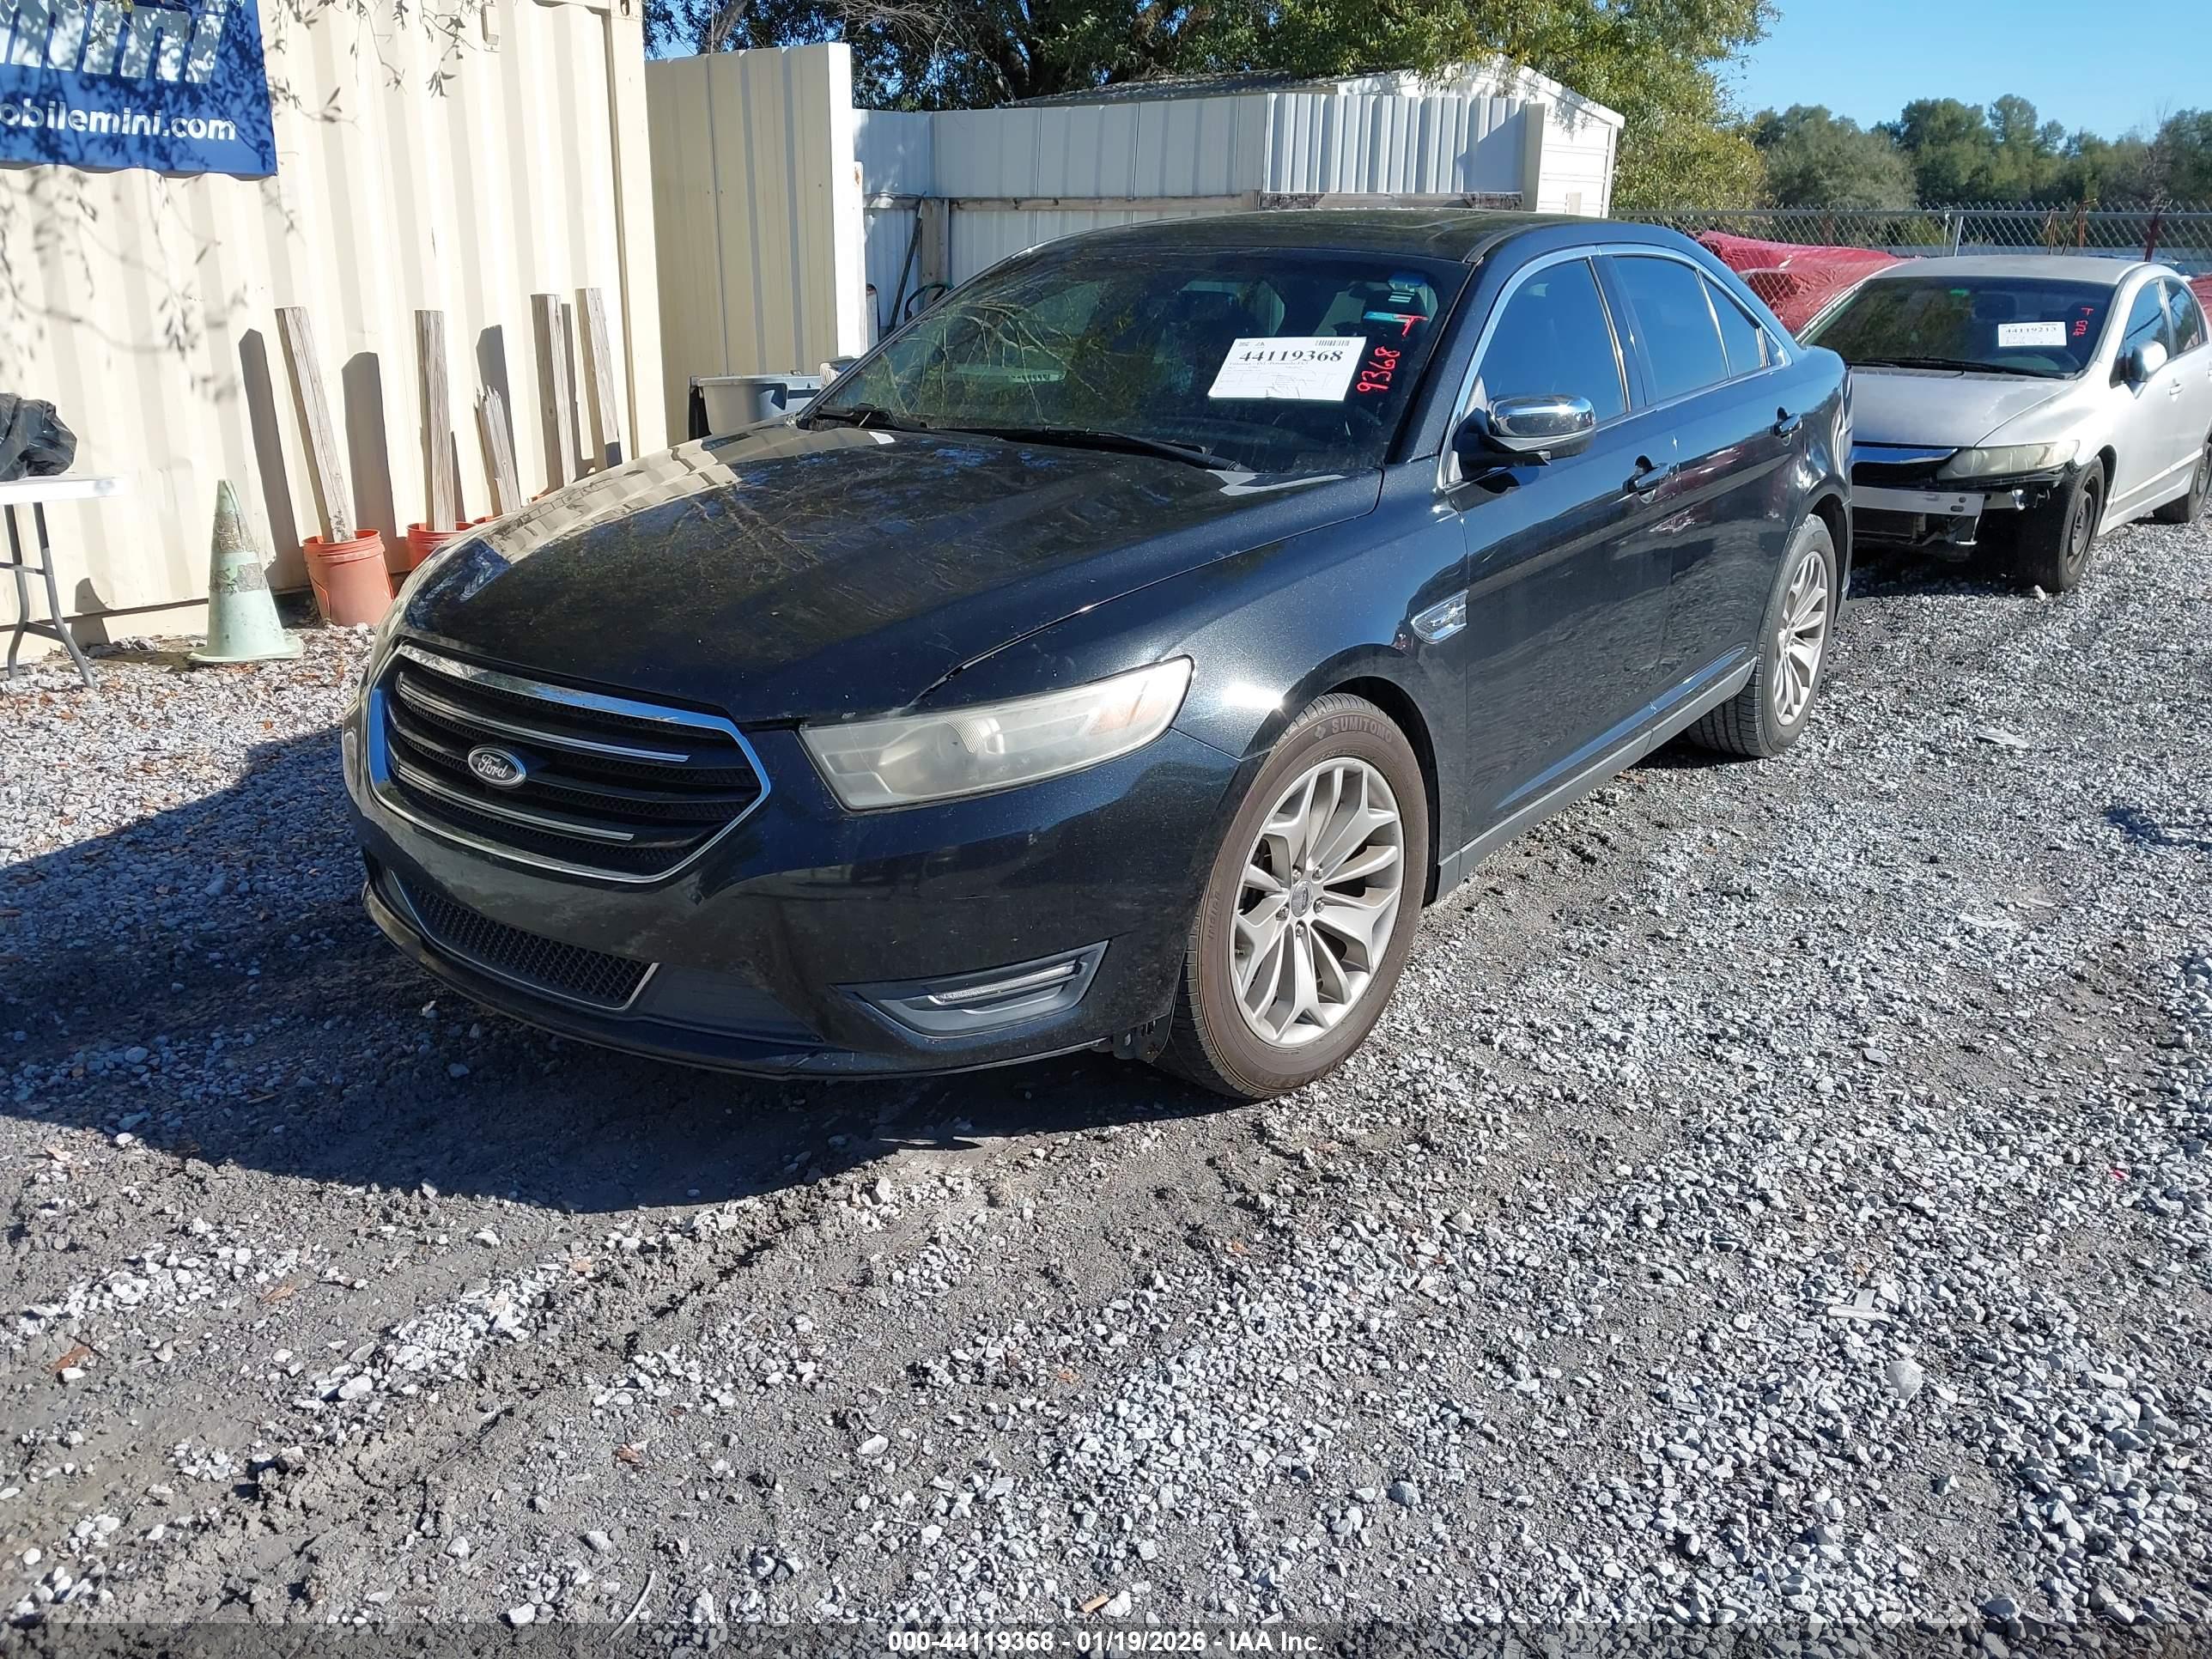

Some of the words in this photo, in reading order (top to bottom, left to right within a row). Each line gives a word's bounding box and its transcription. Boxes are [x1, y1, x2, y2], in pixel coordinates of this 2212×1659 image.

[1395, 313, 1430, 337] T
[1239, 349, 1344, 362] 44119368
[1356, 345, 1401, 392] 9368
[1332, 714, 1393, 744] SUMITOMO
[477, 754, 508, 779] Ford
